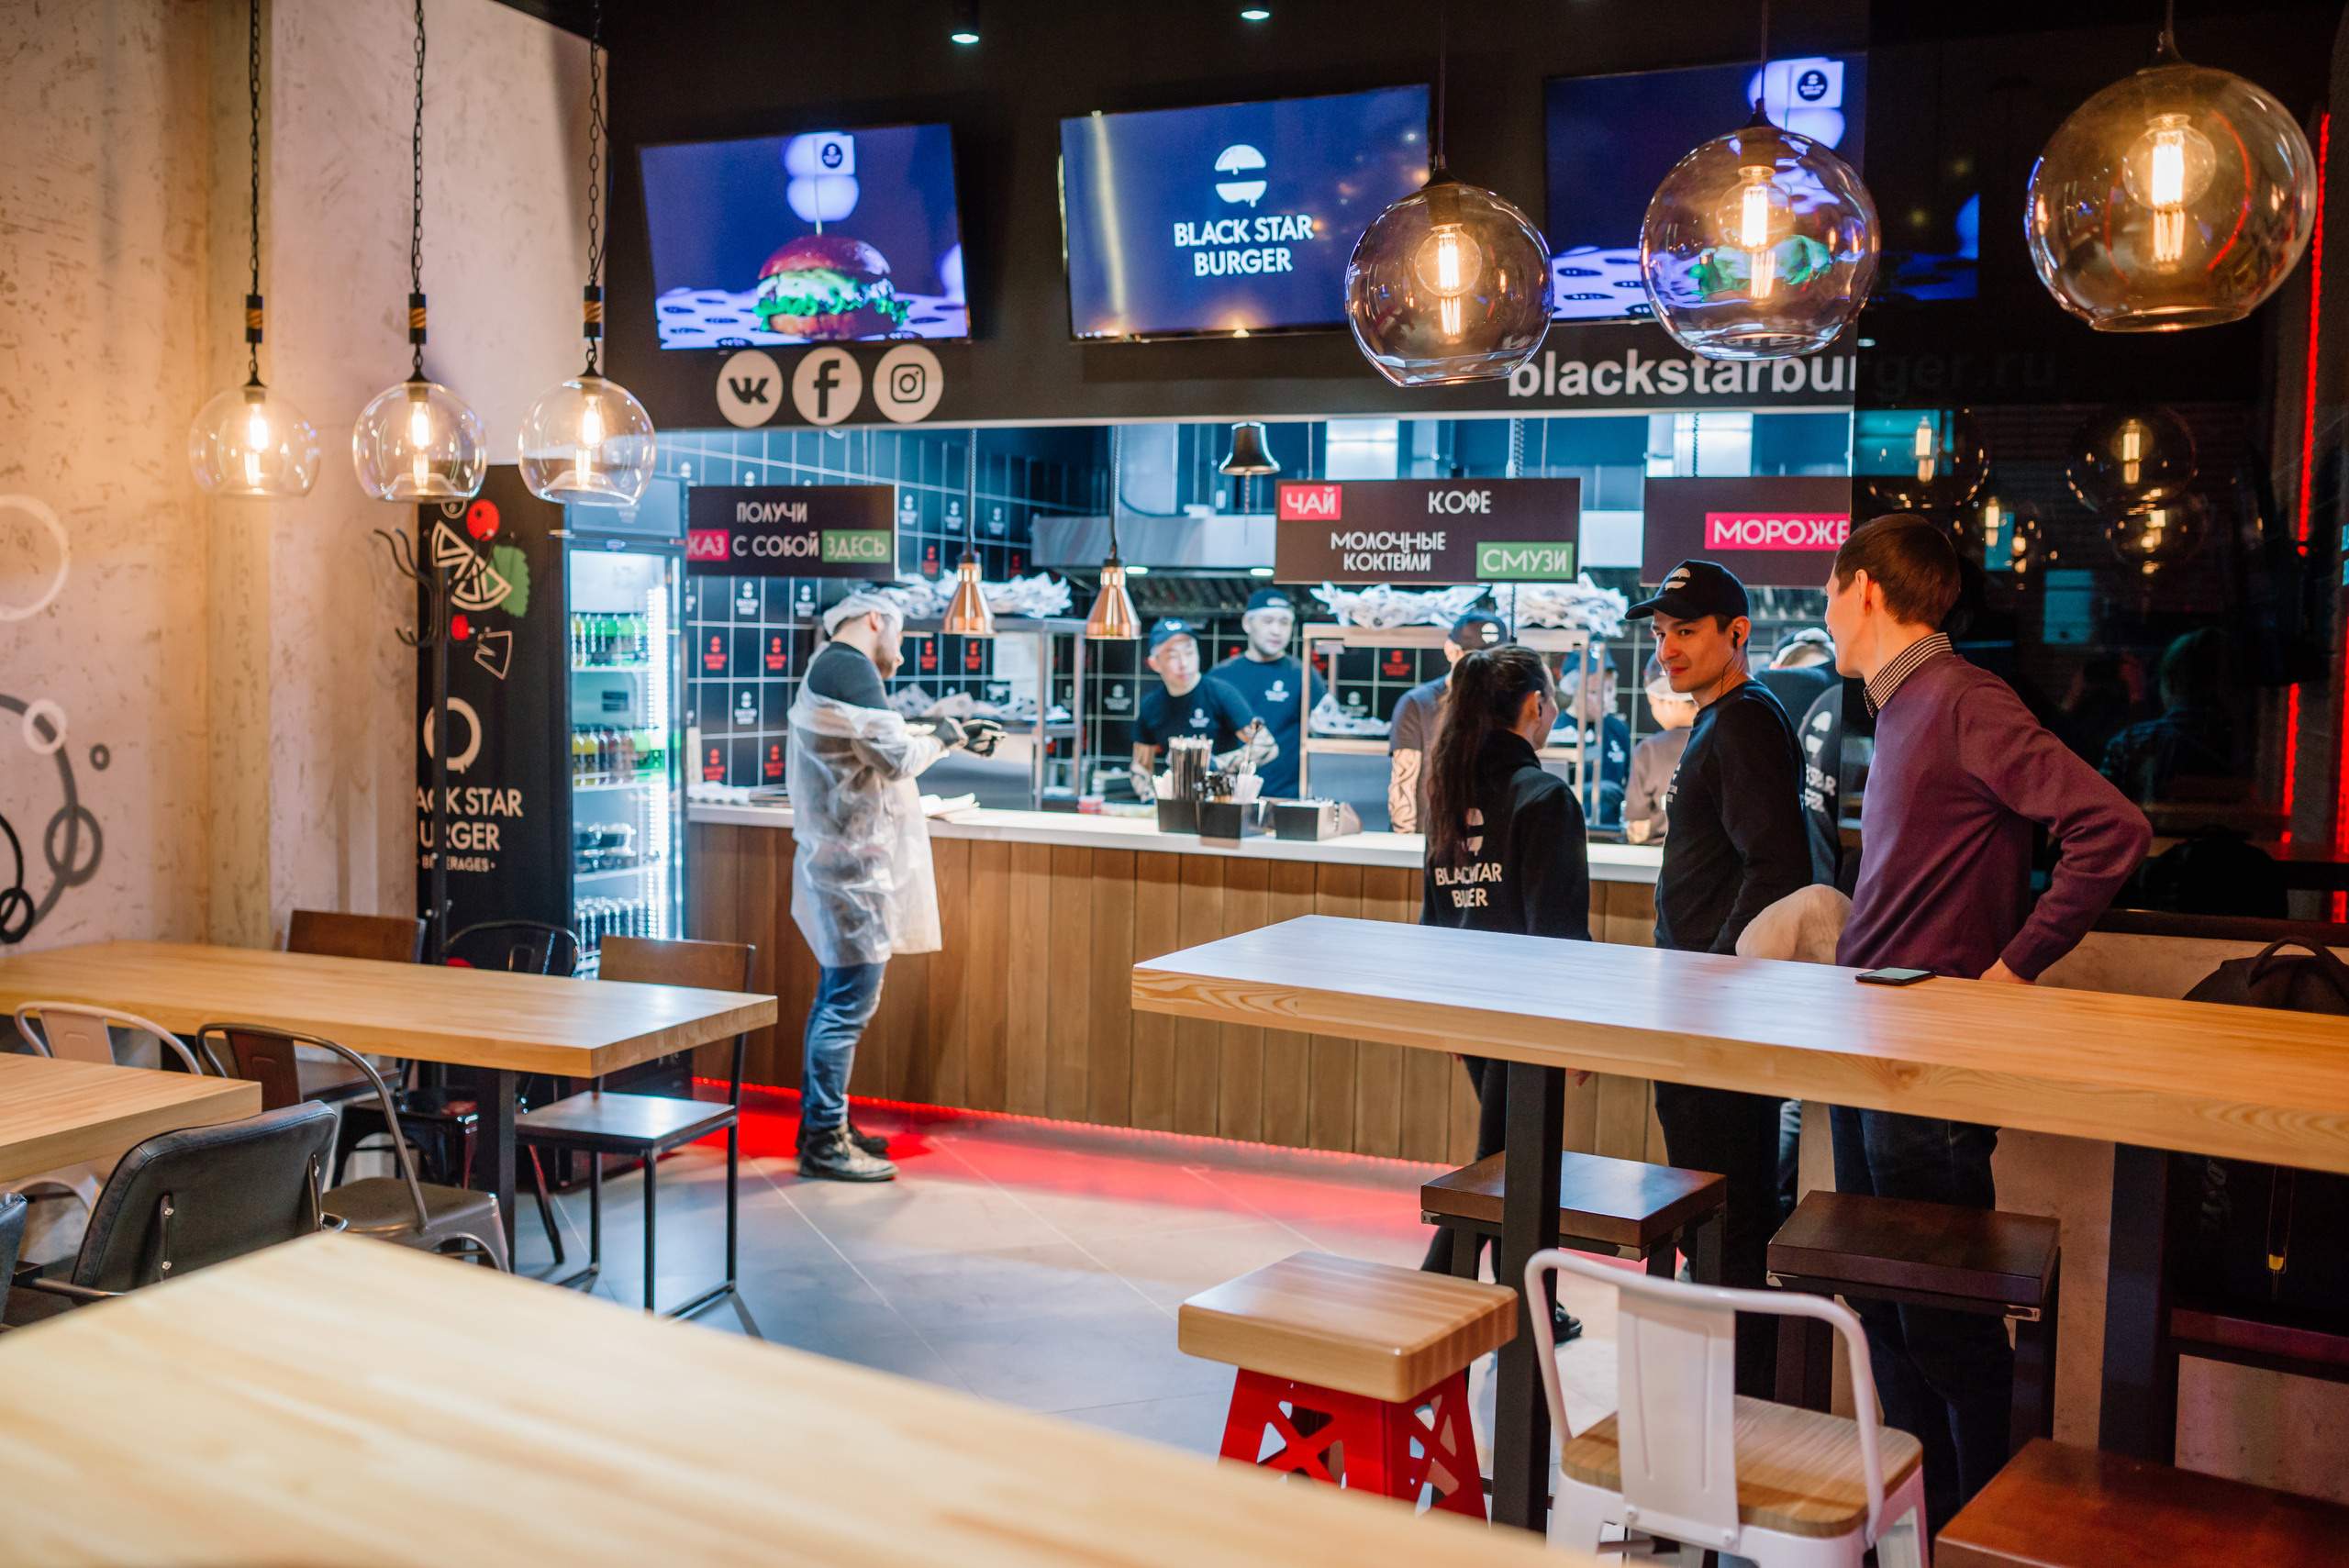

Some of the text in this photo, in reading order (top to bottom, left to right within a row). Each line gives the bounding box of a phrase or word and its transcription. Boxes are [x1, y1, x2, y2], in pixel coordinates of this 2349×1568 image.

[1174, 214, 1314, 247] BLACK STAR
[1194, 247, 1293, 276] BURGER
[736, 502, 807, 523] ПОЛУЧИ
[1286, 487, 1491, 515] ЧАЙ КОФЕ
[732, 535, 748, 557] С
[752, 531, 818, 557] СОБОЙ
[828, 536, 886, 560] ЗДЕСЬ
[1331, 530, 1446, 551] МОЛОЧНЫЕ
[1713, 519, 1849, 545] МОРОЖЕ
[1343, 550, 1431, 572] КОКТЕЙЛИ
[1483, 549, 1567, 573] СМУЗИ
[465, 786, 524, 817] STAR
